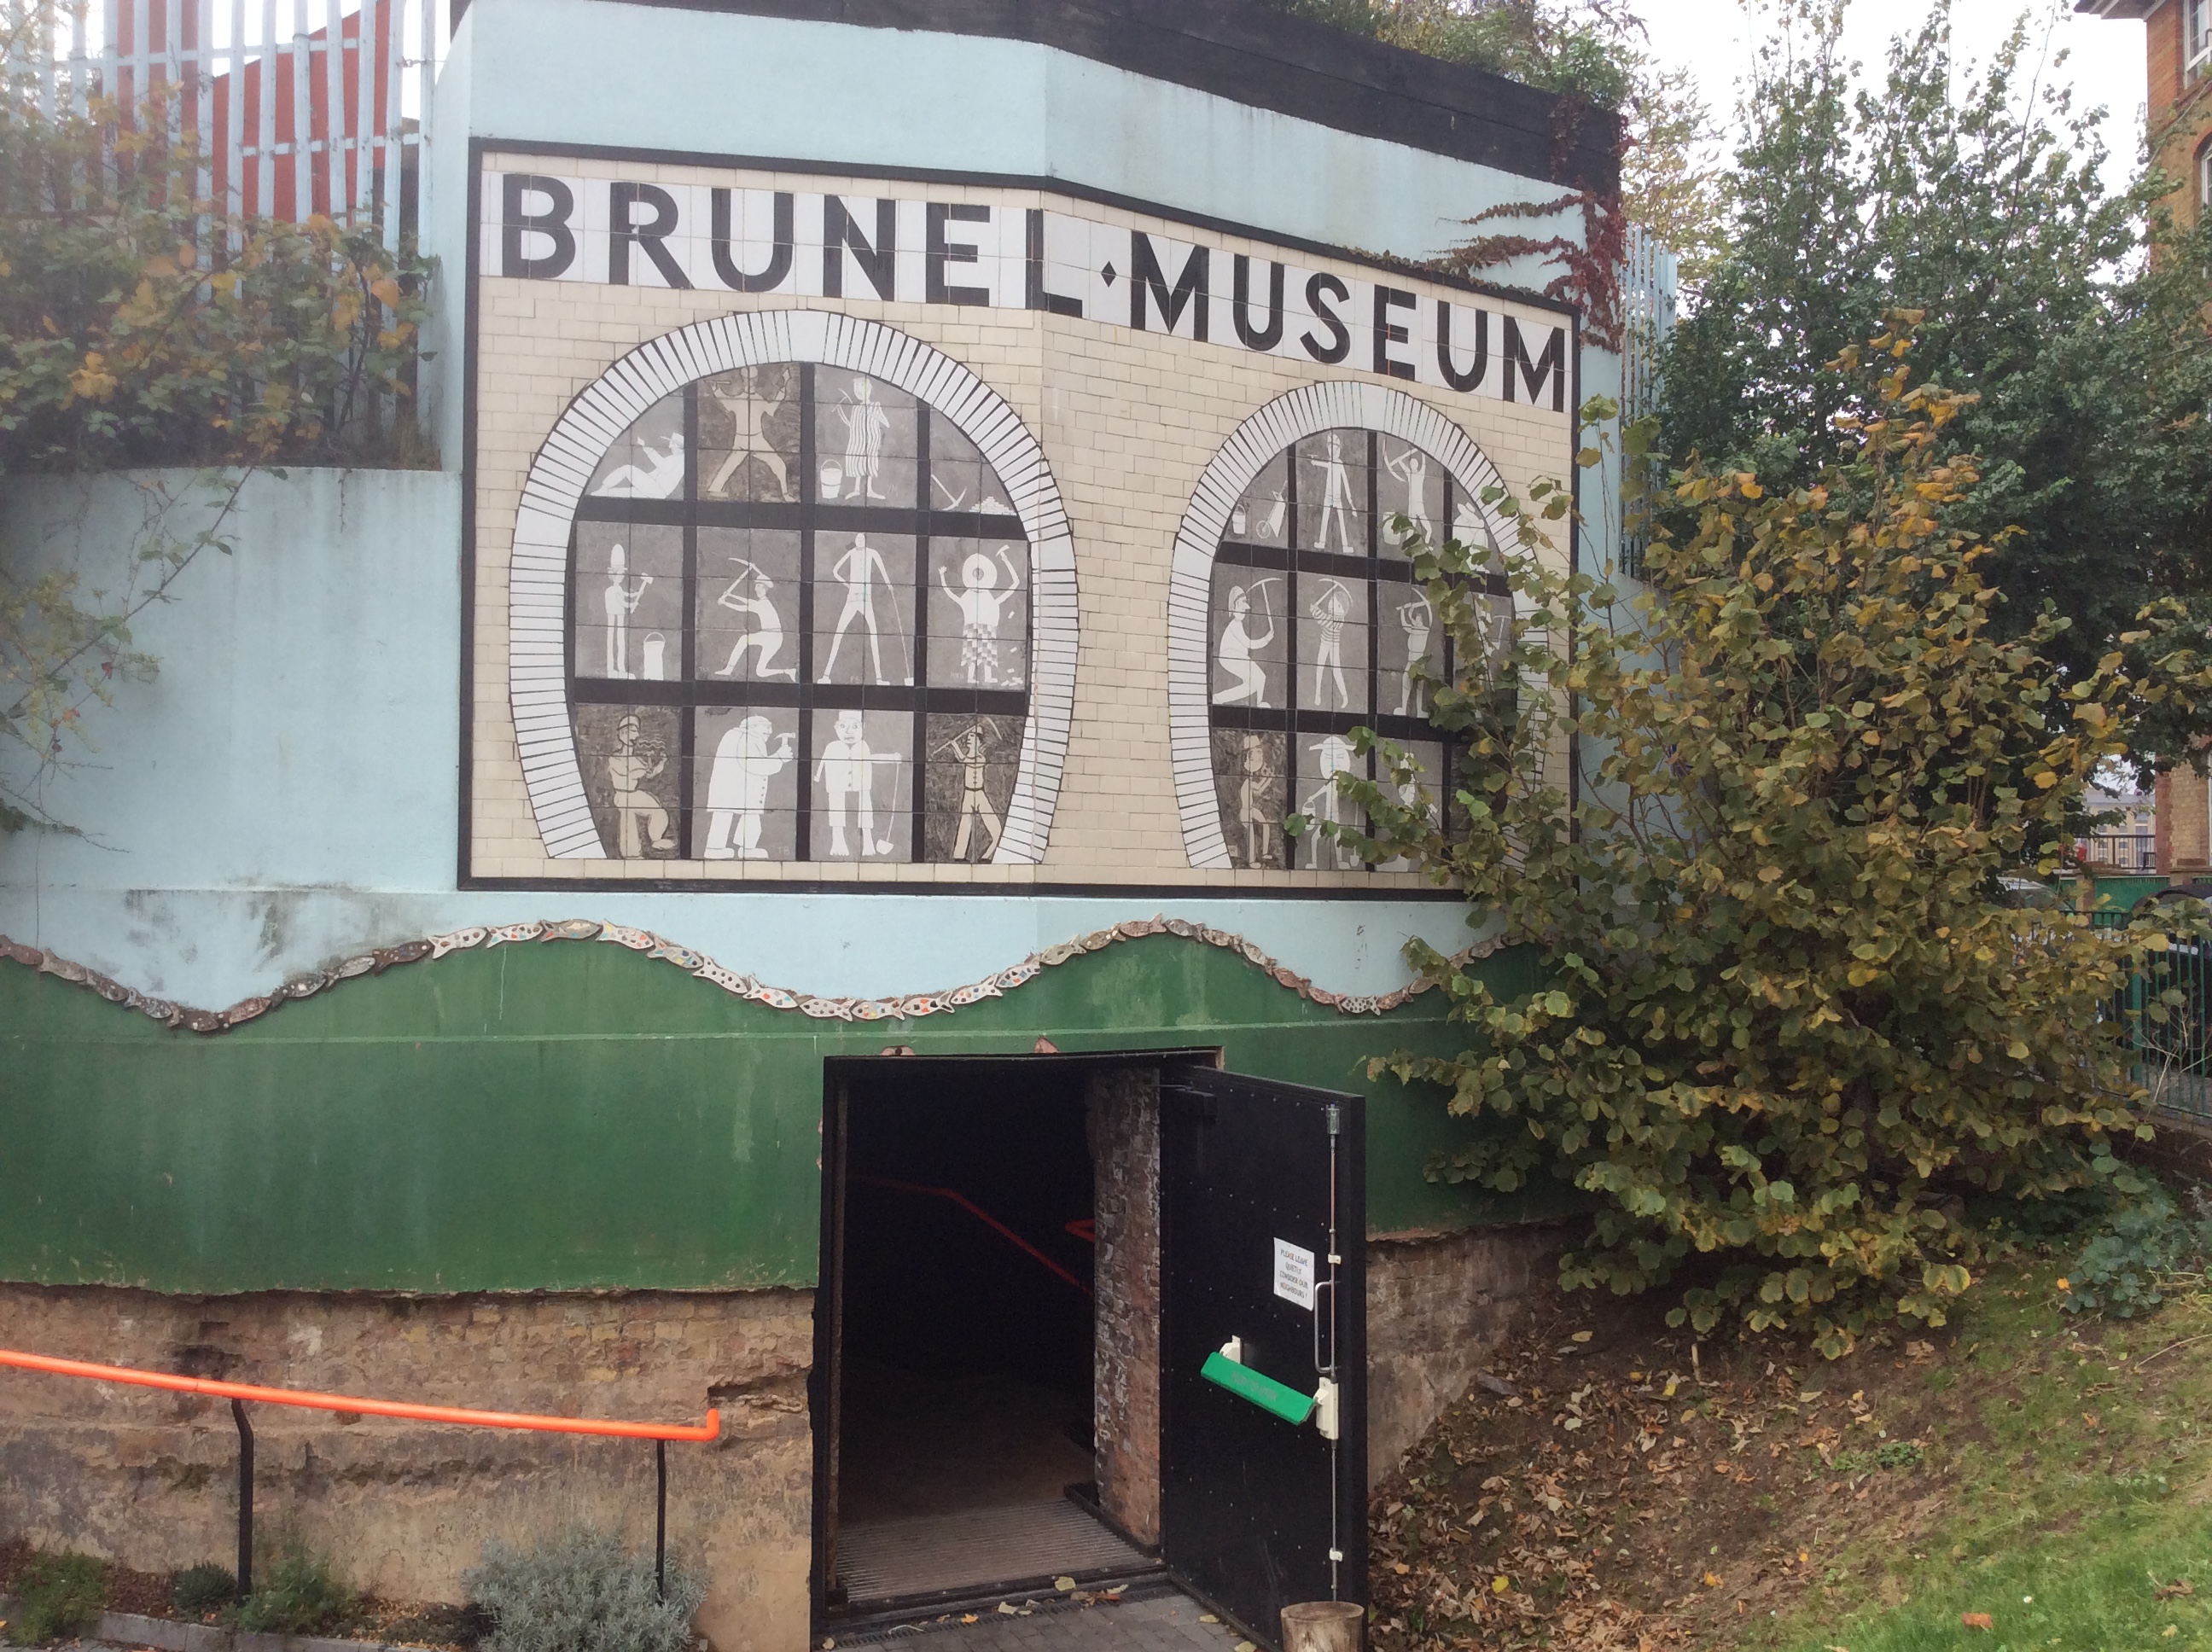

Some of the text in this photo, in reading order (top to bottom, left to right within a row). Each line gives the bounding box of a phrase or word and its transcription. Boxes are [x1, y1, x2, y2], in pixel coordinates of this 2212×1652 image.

[503, 173, 1564, 413] BRUNEL MUSEUM
[1280, 1248, 1295, 1261] PLEASE
[1285, 1262, 1302, 1275] QUIETLY
[1279, 1270, 1298, 1283] CONSIDER
